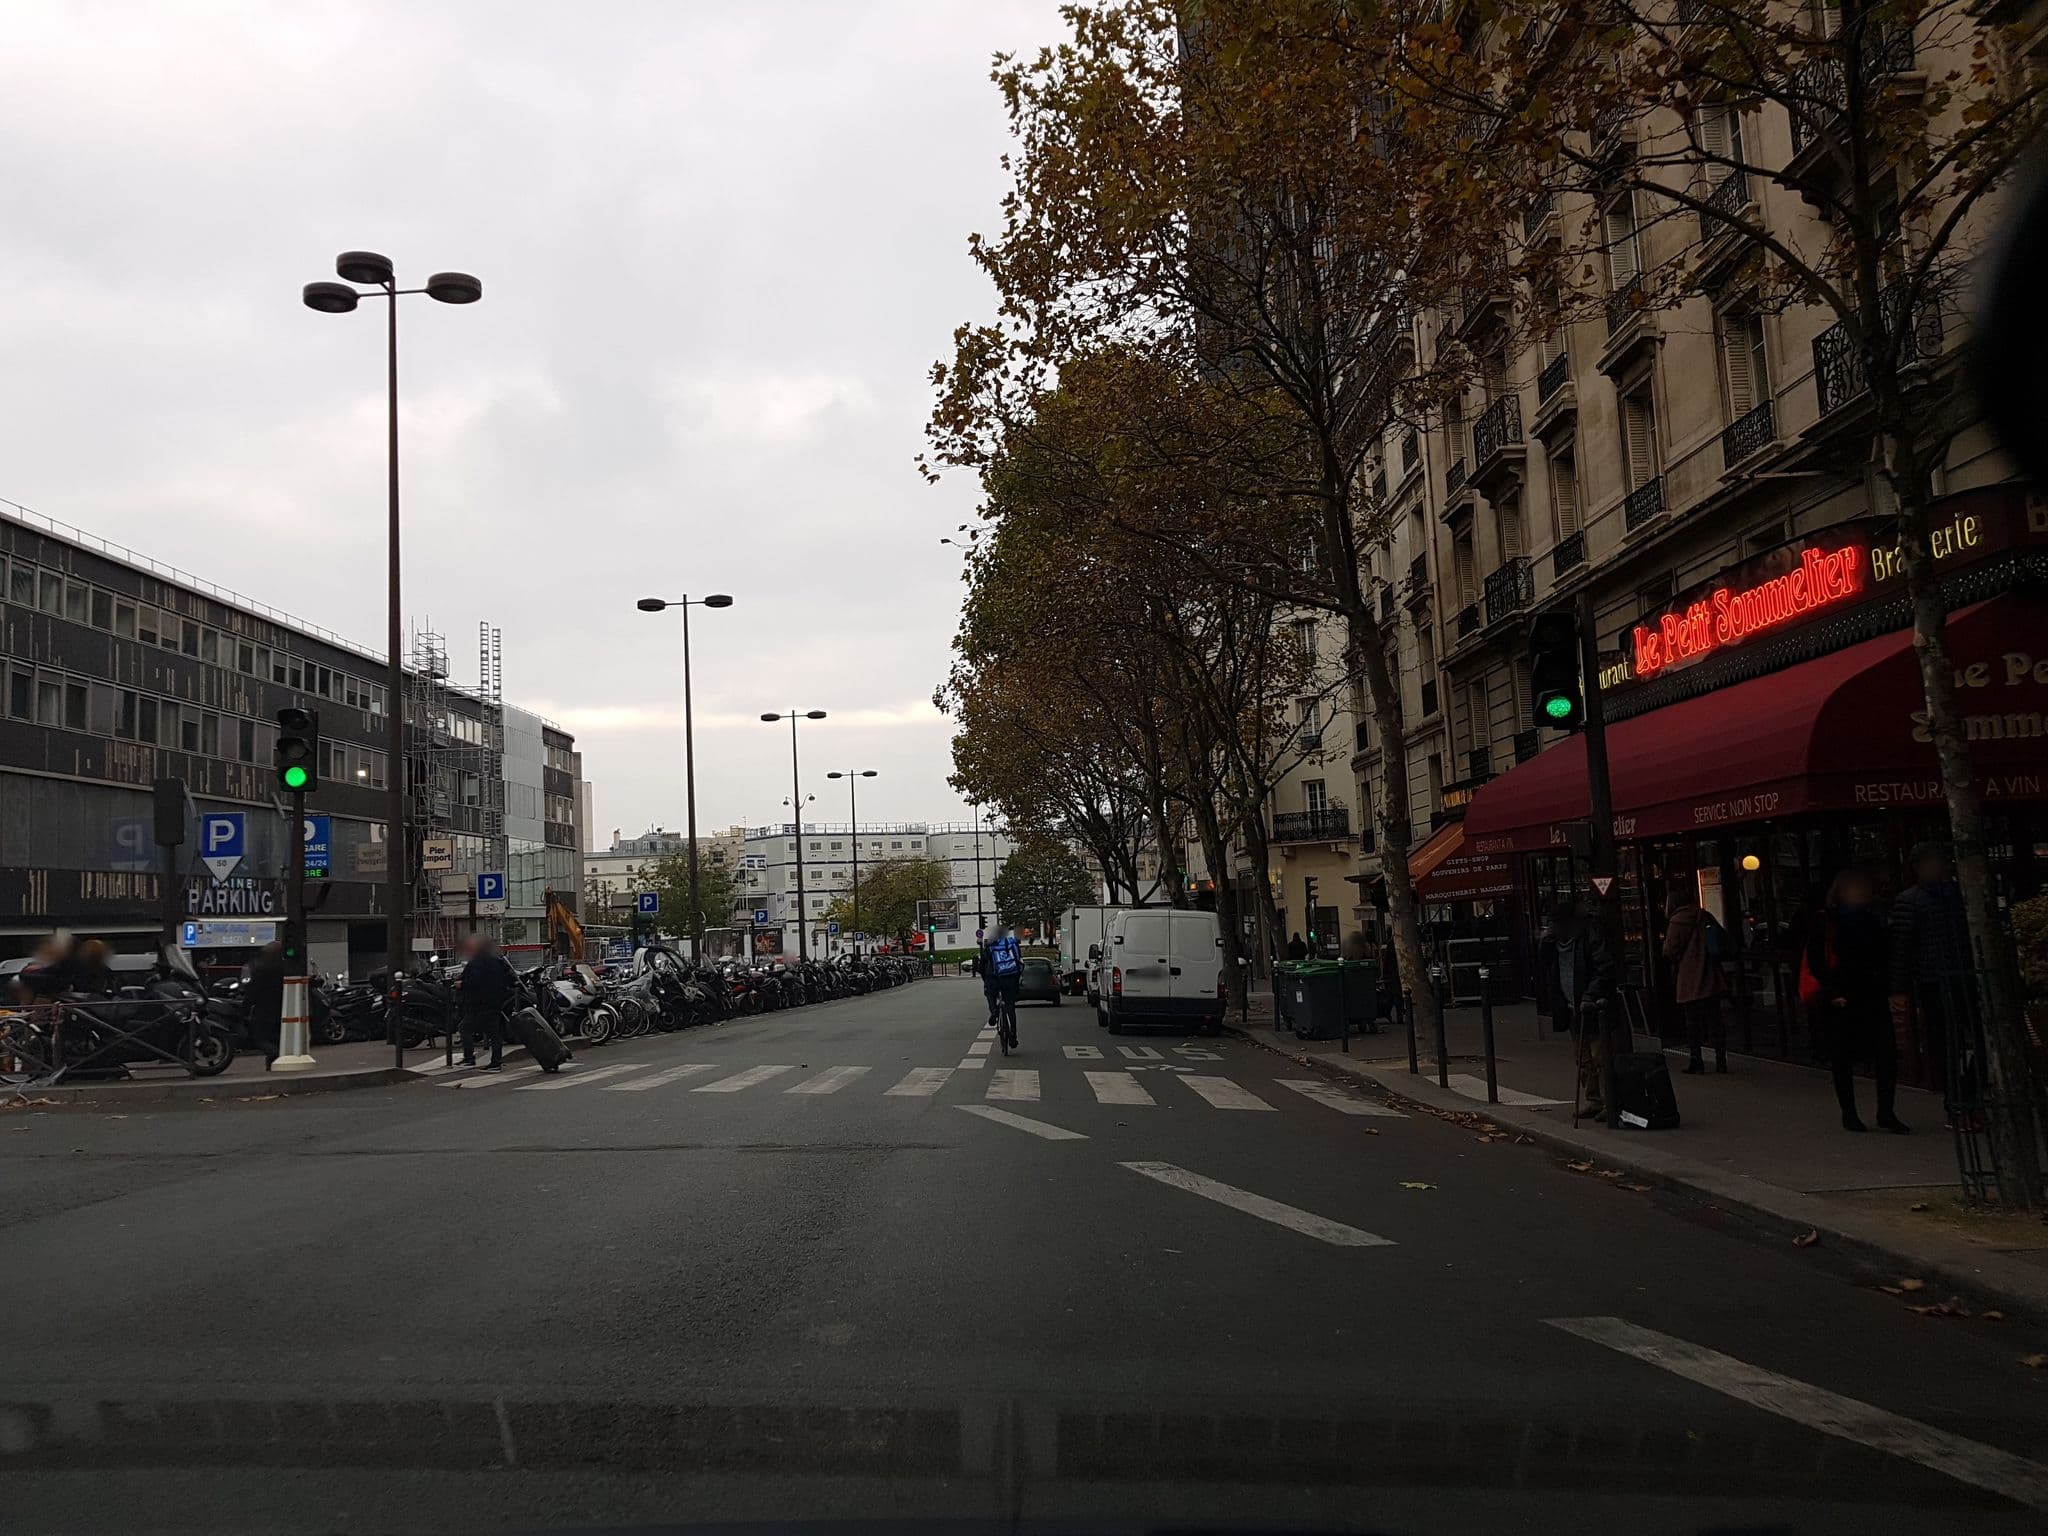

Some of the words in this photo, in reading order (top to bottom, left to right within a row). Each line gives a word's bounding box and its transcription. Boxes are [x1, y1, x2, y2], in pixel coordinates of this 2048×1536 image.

[1872, 512, 1977, 581] Braerie
[1633, 626, 1661, 674] Le
[1661, 600, 1712, 664] Petit
[1714, 545, 1858, 642] Sommelier
[1599, 657, 1632, 690] urant
[2004, 775, 2040, 794] VIN
[1694, 802, 1727, 824] SERVICE
[1729, 798, 1751, 816] NON
[1754, 792, 1779, 813] STOP
[209, 820, 235, 851] P
[1612, 816, 1637, 837] elier
[424, 853, 451, 863] Import
[429, 846, 445, 854] Pier
[484, 878, 497, 895] P
[188, 888, 273, 914] PARKING
[643, 896, 653, 909] P
[758, 910, 767, 922] P
[1063, 1046, 1225, 1060] BUS
